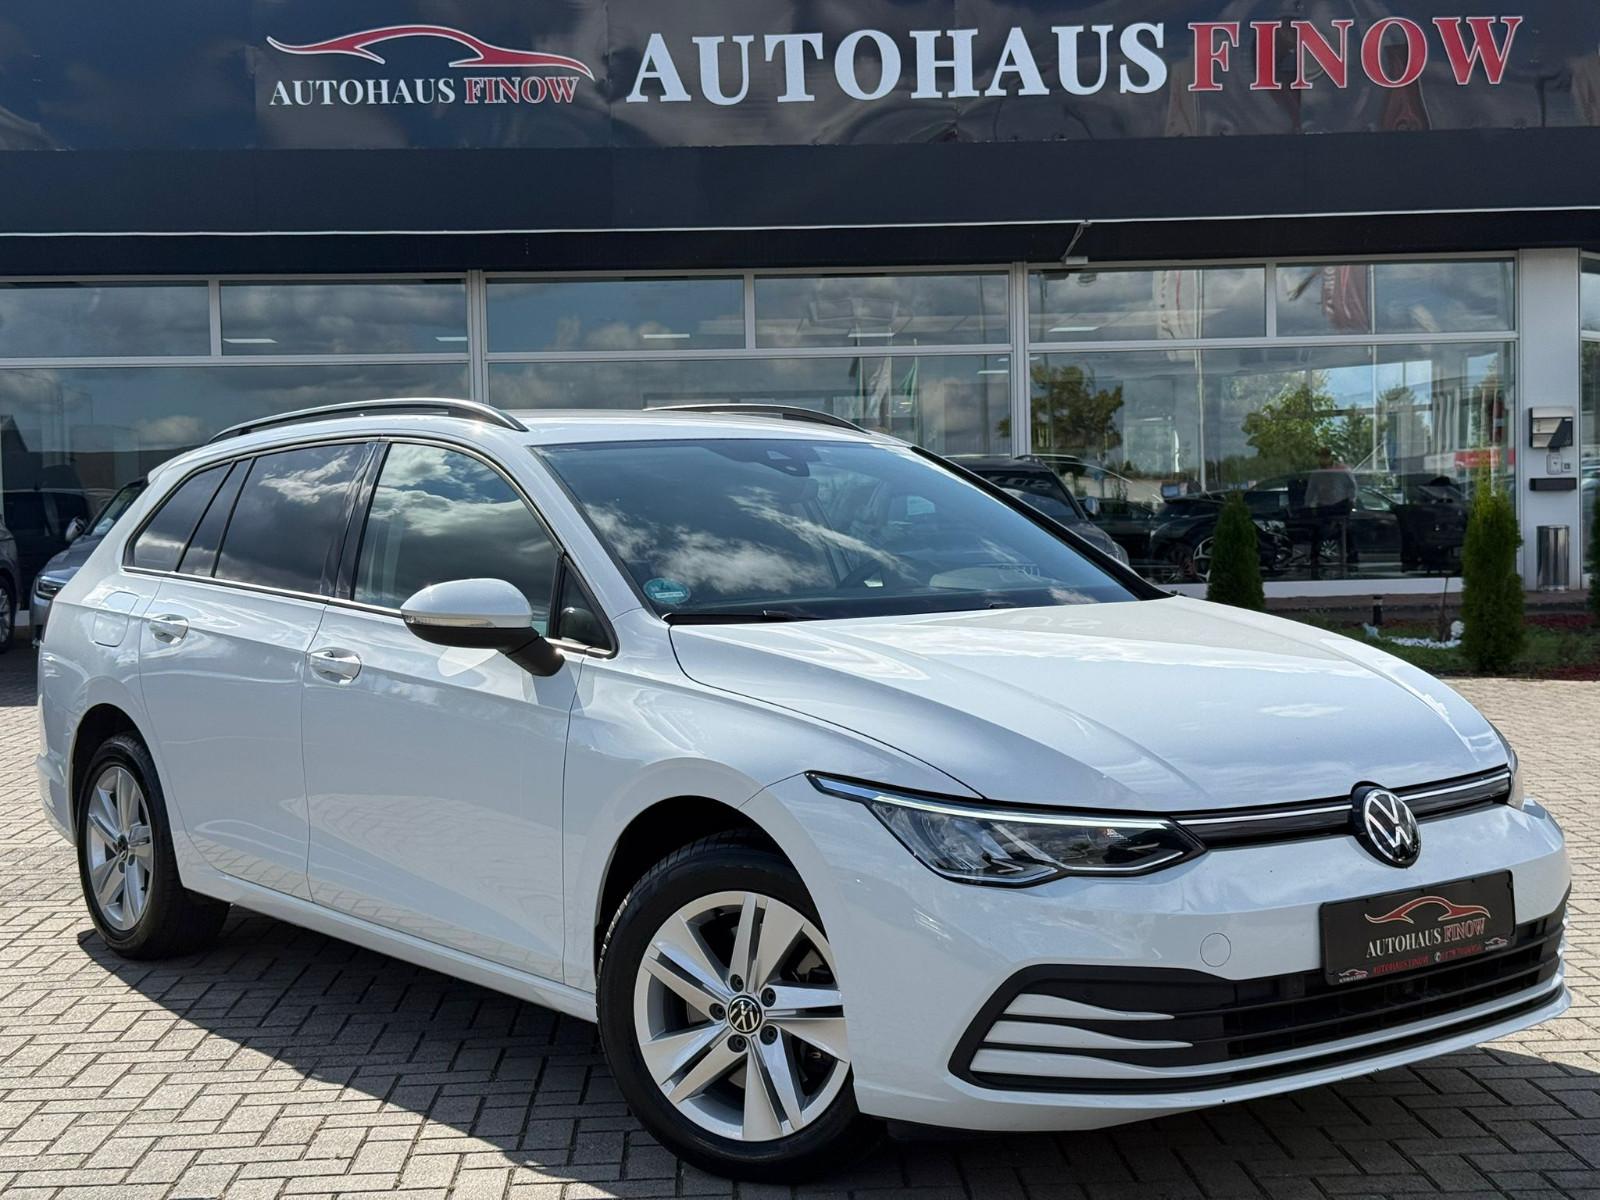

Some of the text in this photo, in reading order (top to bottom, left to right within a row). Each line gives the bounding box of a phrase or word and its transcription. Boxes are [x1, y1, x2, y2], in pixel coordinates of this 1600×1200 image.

[626, 16, 1523, 106] AUTOHAUS FINOW
[269, 76, 579, 106] AUTOHAUS FINOW
[1366, 928, 1441, 958] AUTOHAUS
[1443, 917, 1486, 943] FINOW
